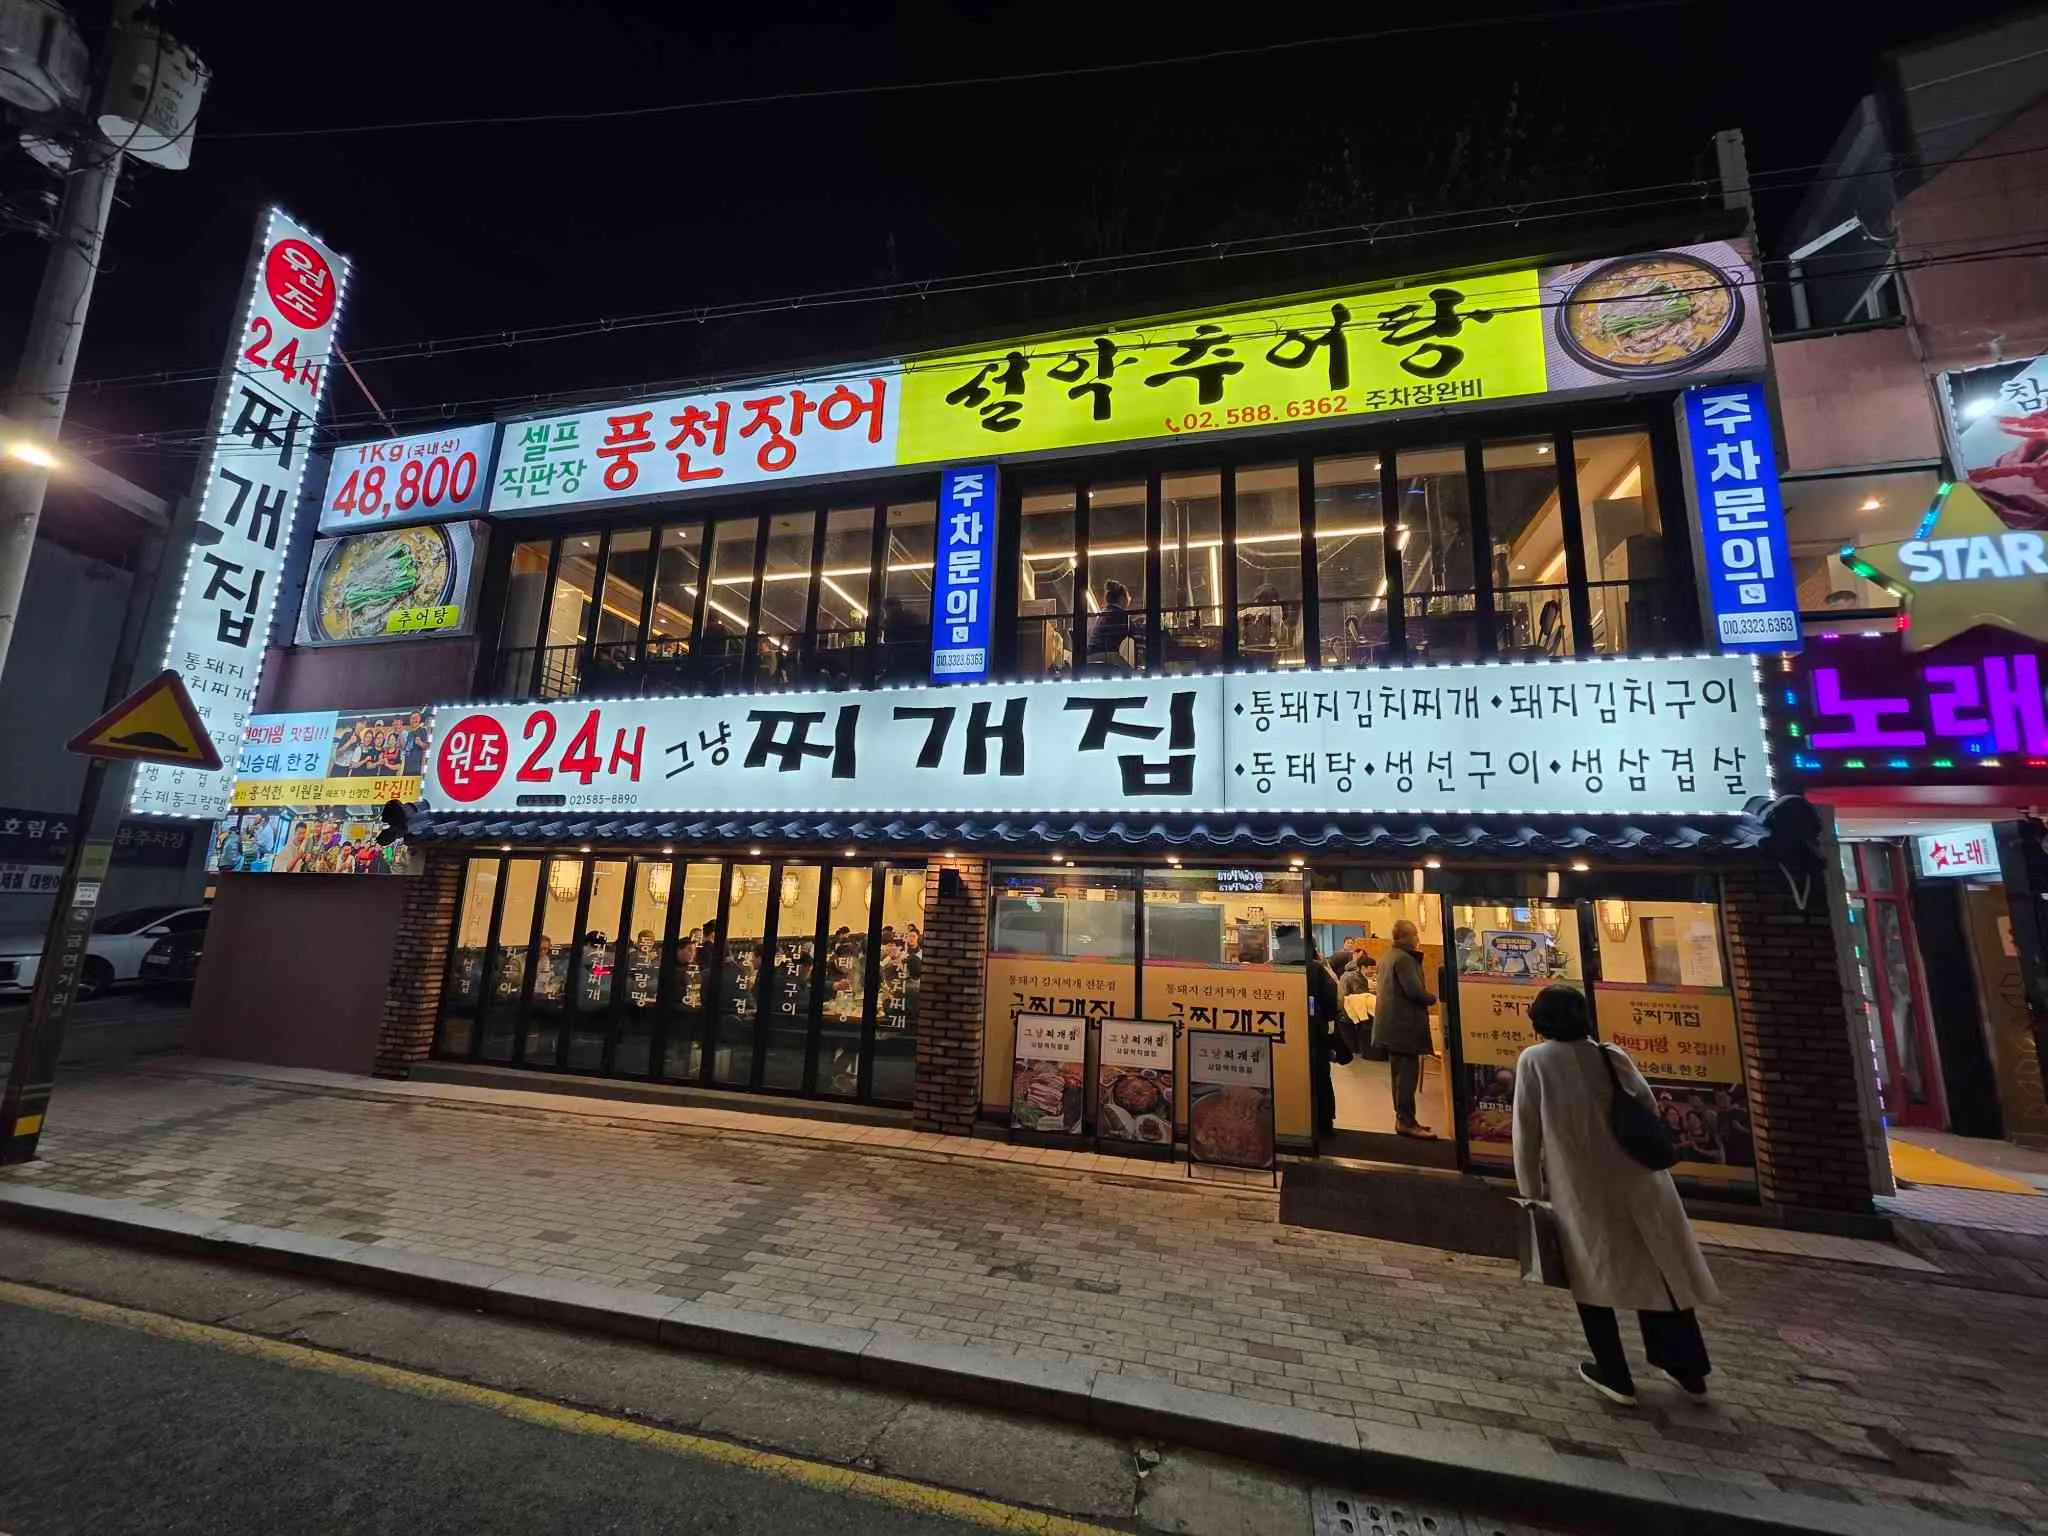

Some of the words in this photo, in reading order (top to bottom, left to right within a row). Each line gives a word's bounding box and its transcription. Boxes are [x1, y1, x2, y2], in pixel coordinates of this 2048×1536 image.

[275, 247, 327, 321] 원조
[1366, 379, 1483, 409] 주차장완비
[407, 438, 460, 458] (국내산)
[518, 421, 579, 463] 셀프
[596, 378, 887, 491] 풍천장어
[331, 451, 477, 519] 48,800
[500, 458, 587, 498] 직판장
[1701, 393, 1775, 581] 주차문의
[201, 385, 303, 648] 찌개집
[945, 474, 983, 624] 주차문의
[1898, 533, 2048, 582] STAR
[398, 607, 449, 627] 추어탕
[178, 674, 251, 703] 치찌개
[184, 652, 244, 679] 통돼지
[1249, 685, 1480, 732] 통돼지김치찌개
[1509, 678, 1738, 724] 돼지김치구이
[446, 733, 500, 785] 원조
[664, 720, 732, 780] 그냥
[743, 691, 1197, 796] 찌개집
[1250, 751, 1356, 794] 동태탕
[1384, 750, 1540, 794] 생선구이
[1571, 746, 1747, 797] 생삼겹살
[1950, 839, 1984, 865] 노래
